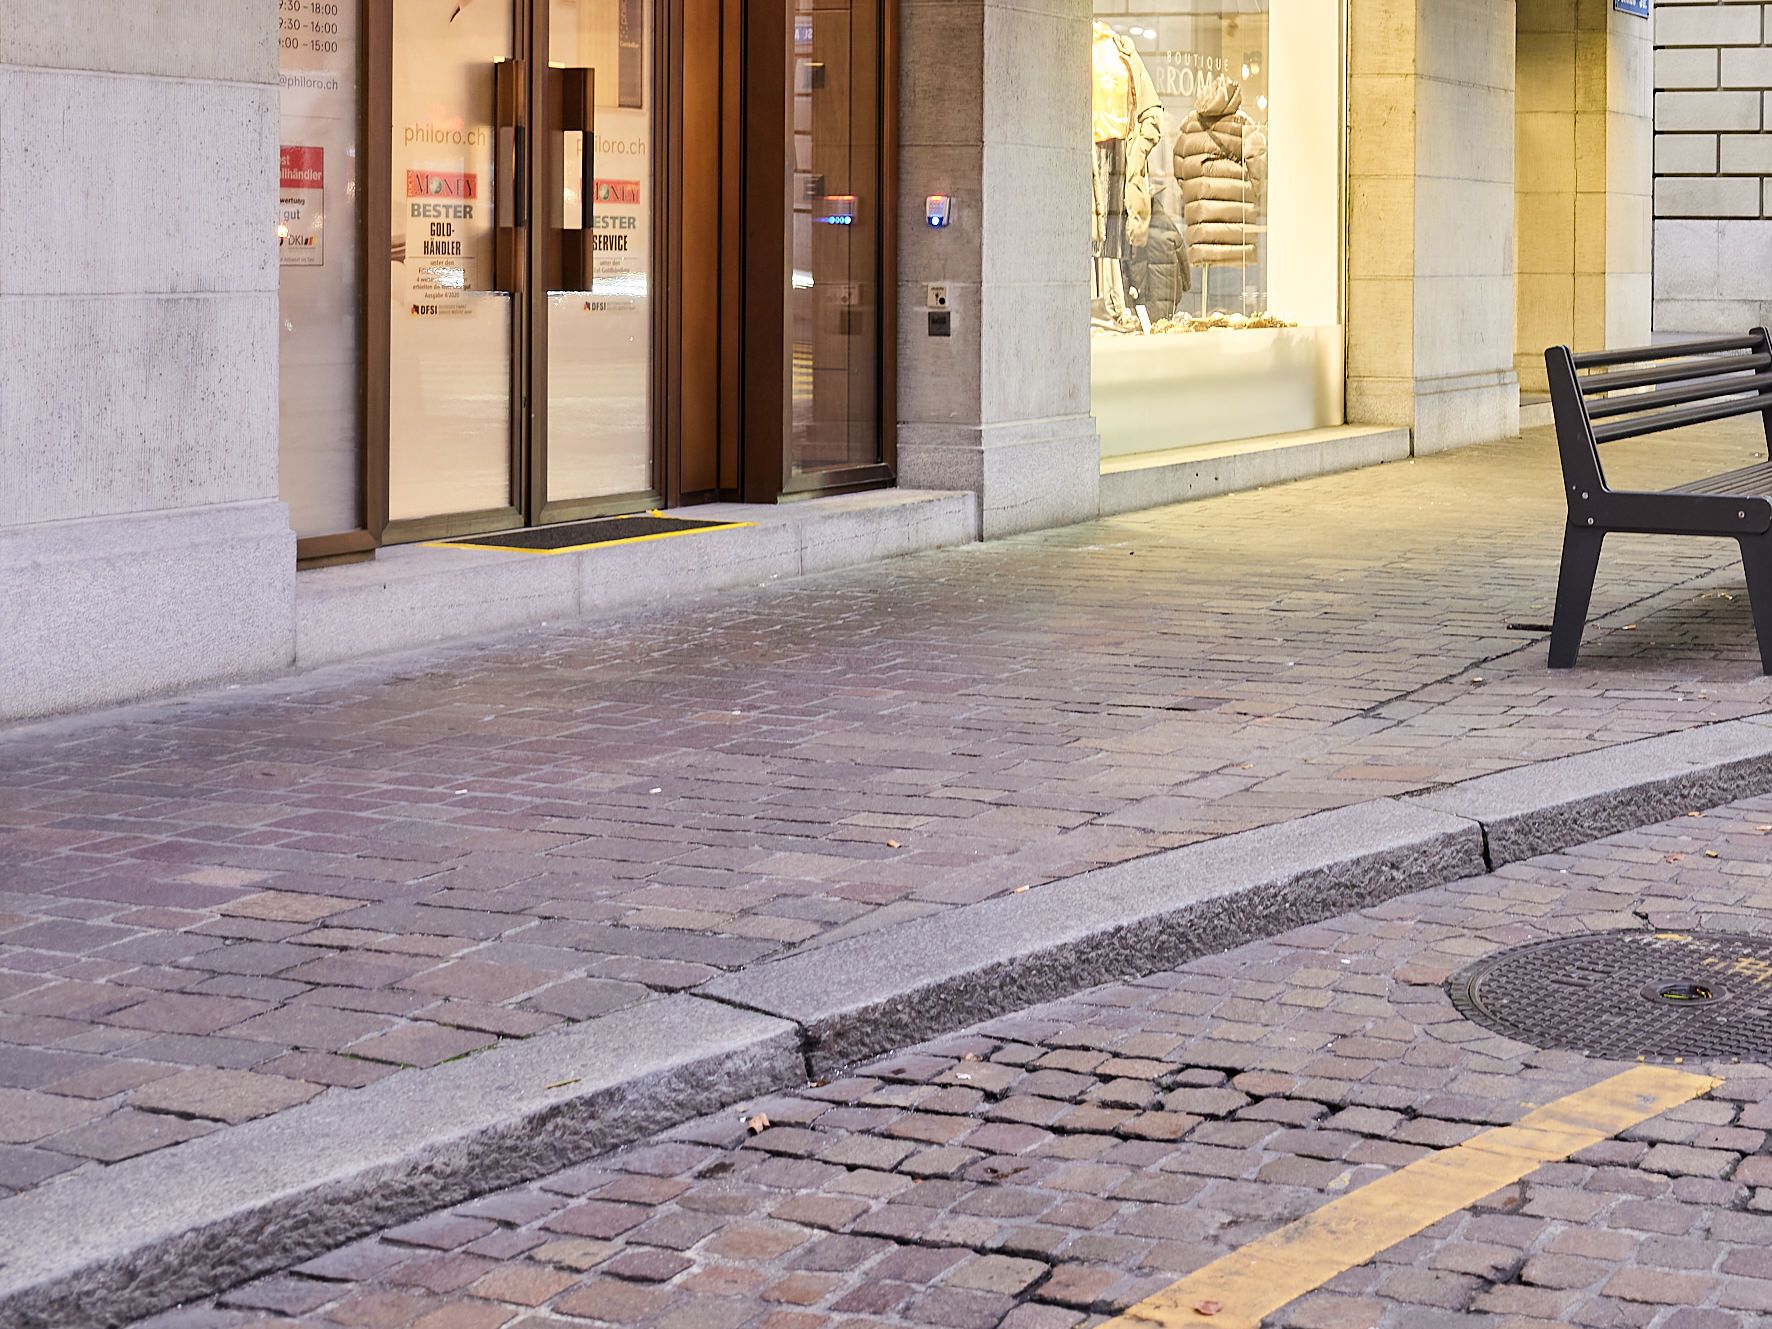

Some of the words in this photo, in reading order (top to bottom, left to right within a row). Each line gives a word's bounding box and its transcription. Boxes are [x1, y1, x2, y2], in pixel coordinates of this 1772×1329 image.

[311, 2, 338, 16] 18:00
[311, 21, 338, 35] 16:00
[279, 37, 299, 49] :00
[311, 40, 338, 53] 15:00
[1166, 50, 1230, 72] BOUTIQUE
[279, 75, 338, 91] @philoro.ch
[405, 123, 486, 147] philoro.ch
[576, 136, 646, 157] piloro.ch
[280, 168, 322, 182] llhändler
[280, 197, 306, 206] wertung
[283, 208, 301, 221] gut
[411, 202, 474, 220] BESTER
[430, 222, 455, 238] GOLD-
[593, 215, 637, 230] ESTER
[423, 237, 462, 256] HÄNDLER
[592, 234, 628, 252] SERVICE
[420, 304, 438, 315] DFSI
[592, 301, 607, 312] DFSI
